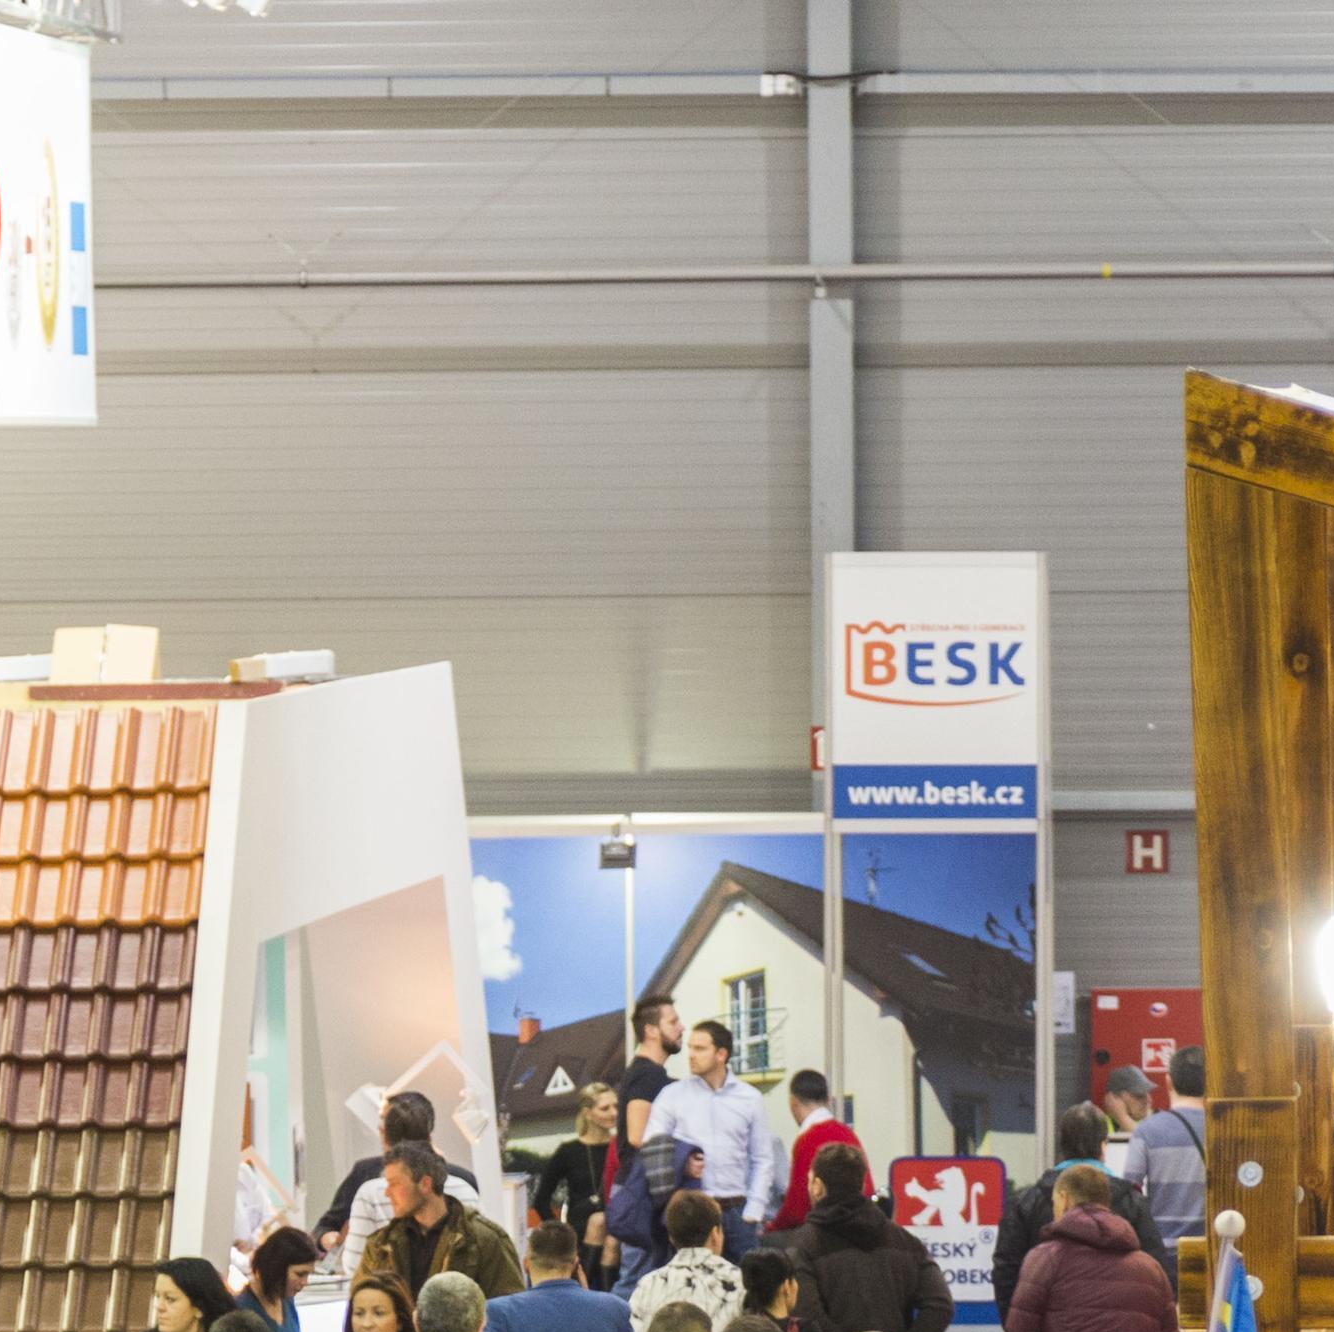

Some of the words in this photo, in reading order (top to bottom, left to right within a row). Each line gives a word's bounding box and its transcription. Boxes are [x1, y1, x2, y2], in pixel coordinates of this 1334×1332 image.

[863, 641, 1025, 686] BESK
[847, 779, 1024, 806] www.besk.cz
[1131, 834, 1164, 870] H
